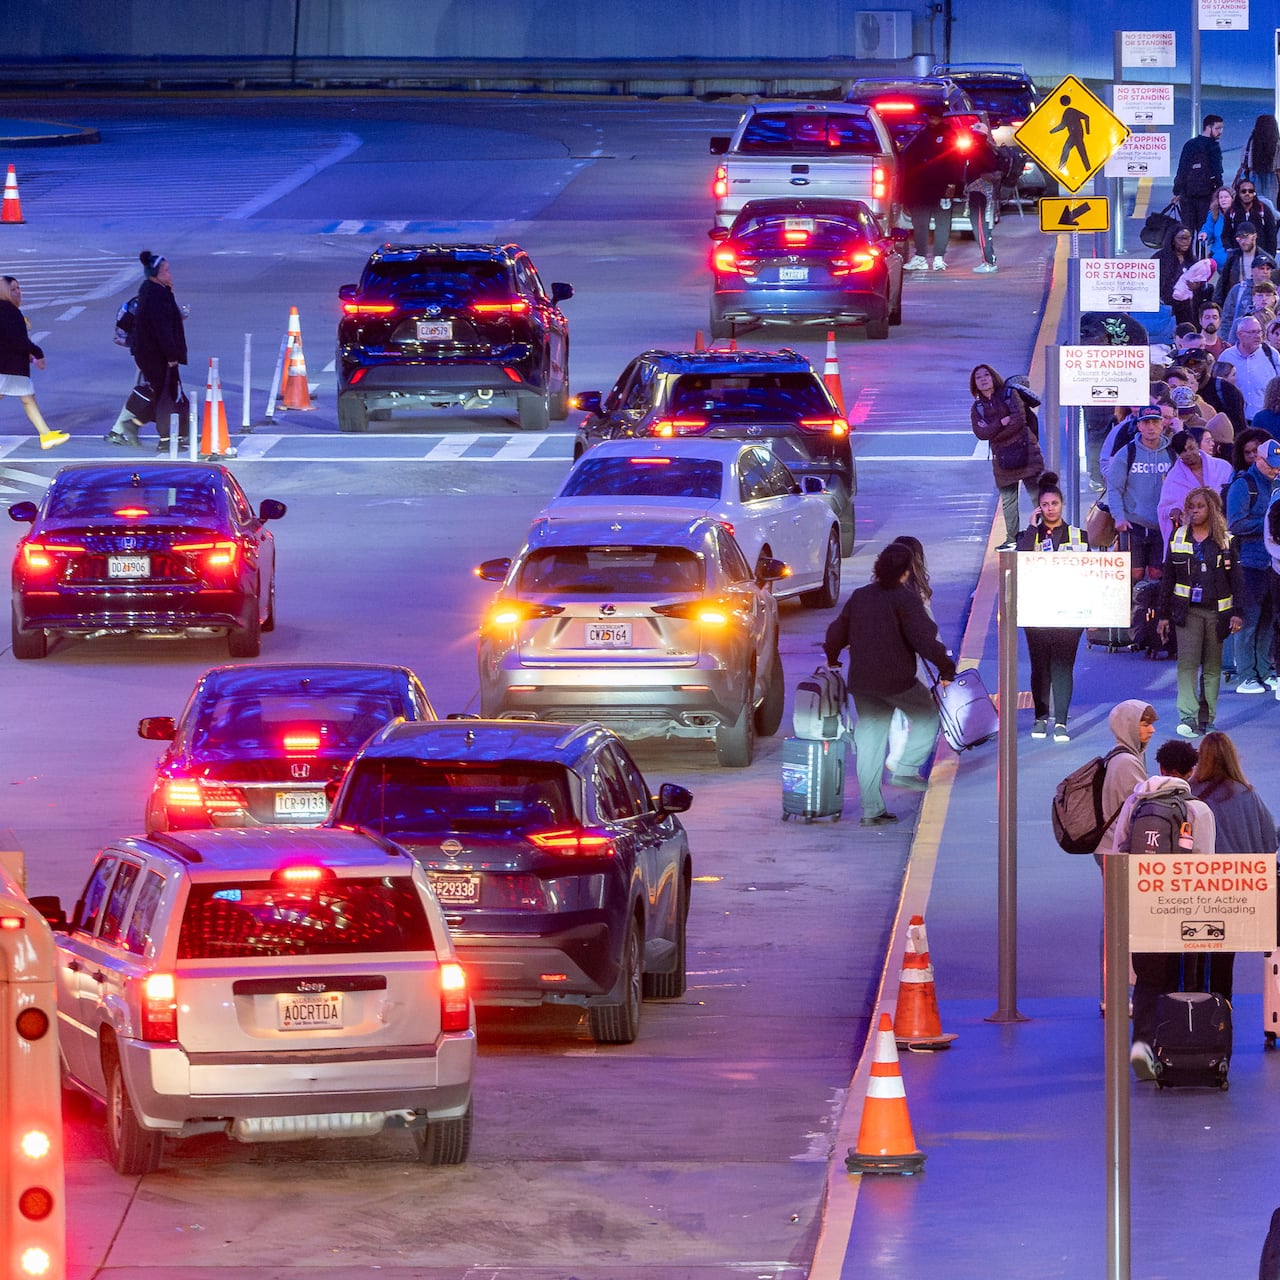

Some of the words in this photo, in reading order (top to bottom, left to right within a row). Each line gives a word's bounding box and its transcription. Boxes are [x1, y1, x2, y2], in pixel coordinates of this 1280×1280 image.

[1085, 262, 1101, 270] NO
[1104, 262, 1155, 270] STOPPING
[1085, 271, 1100, 279] OR
[1103, 271, 1156, 279] STANDING
[1066, 349, 1083, 358] NO
[1087, 349, 1144, 358] STOPPING
[1065, 360, 1081, 369] OR
[1085, 360, 1145, 369] STANDING
[1138, 862, 1166, 876] NO
[1172, 861, 1267, 875] STOPPING
[1137, 879, 1165, 893] OR
[1171, 878, 1268, 892] STANDING
[1158, 896, 1194, 905] Except
[1196, 895, 1211, 904] for
[1214, 895, 1248, 904] Active
[1150, 906, 1192, 915] Loading
[1203, 905, 1256, 915] Unloading
[296, 981, 326, 992] Jeep
